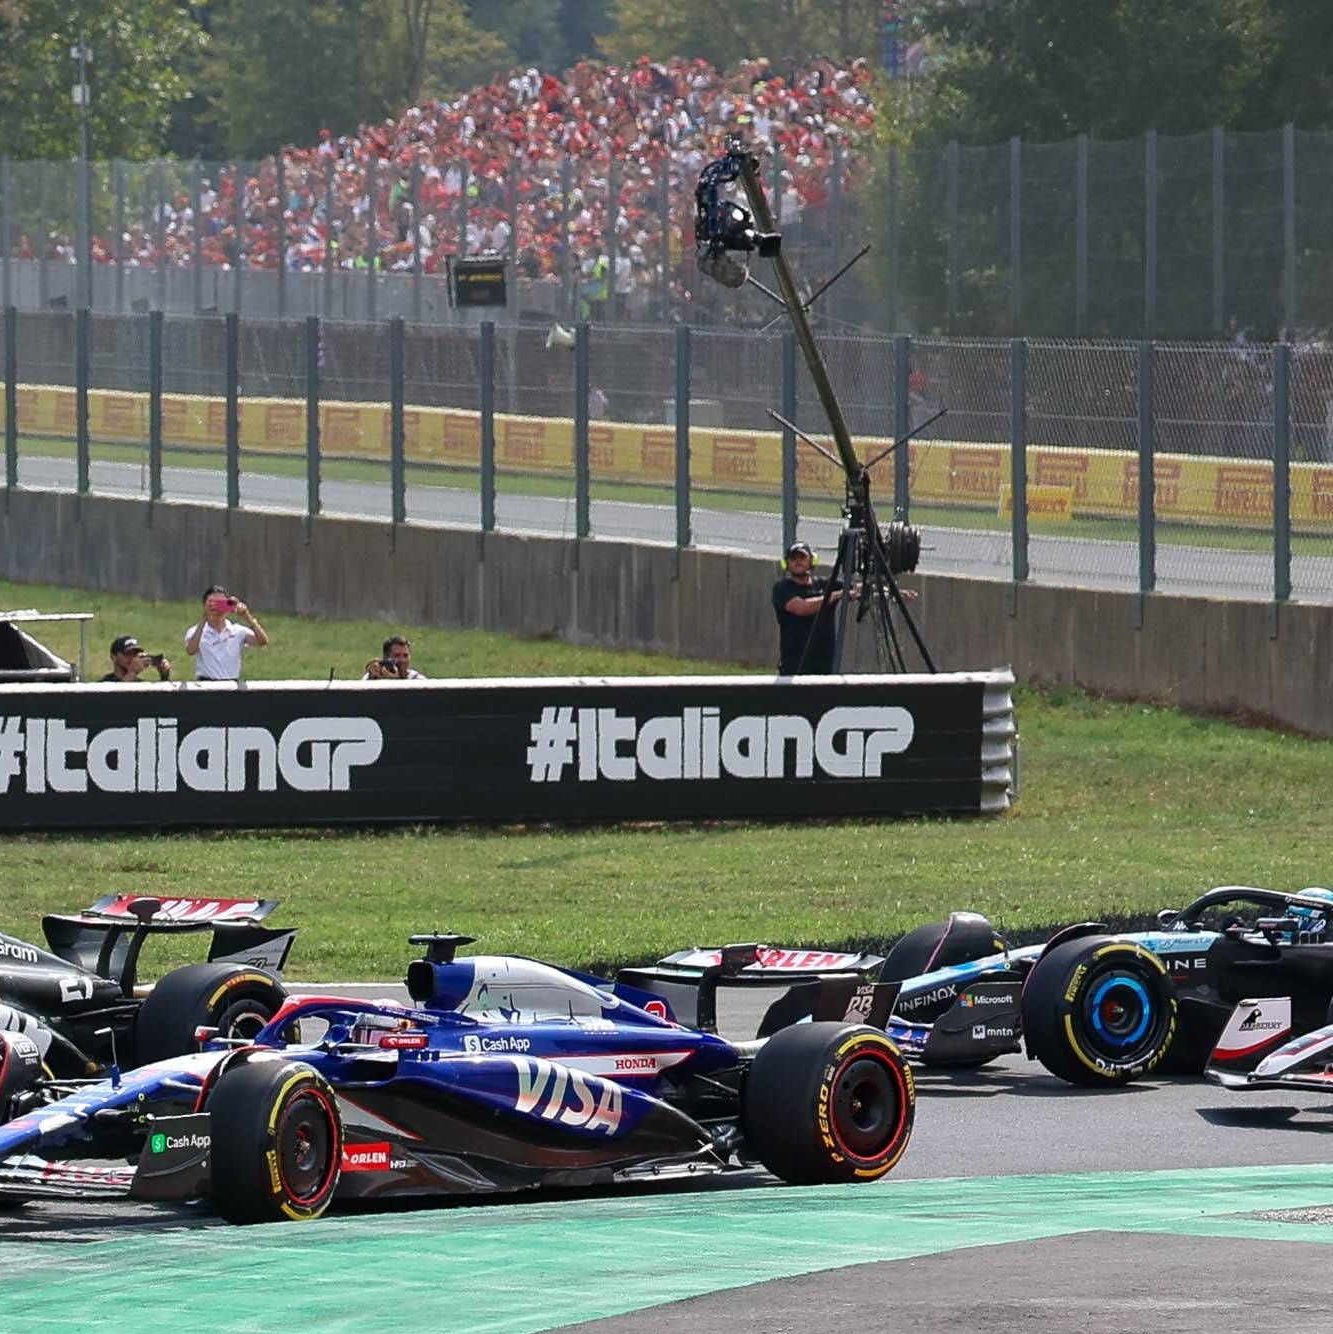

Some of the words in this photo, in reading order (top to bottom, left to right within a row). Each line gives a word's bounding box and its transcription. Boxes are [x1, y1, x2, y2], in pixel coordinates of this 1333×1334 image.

[527, 705, 915, 783] #ItalianGP
[899, 984, 958, 1014] INFINOX
[974, 993, 1014, 1005] Microsoft
[986, 1027, 1014, 1038] mntn
[483, 1037, 508, 1052] Cash
[509, 1037, 531, 1053] App
[615, 1057, 657, 1070] HONDA
[509, 1056, 623, 1136] VISA
[818, 1083, 836, 1150] ZERO
[166, 1135, 188, 1150] Cash
[189, 1133, 211, 1151] App
[350, 1151, 387, 1165] ORLEN
